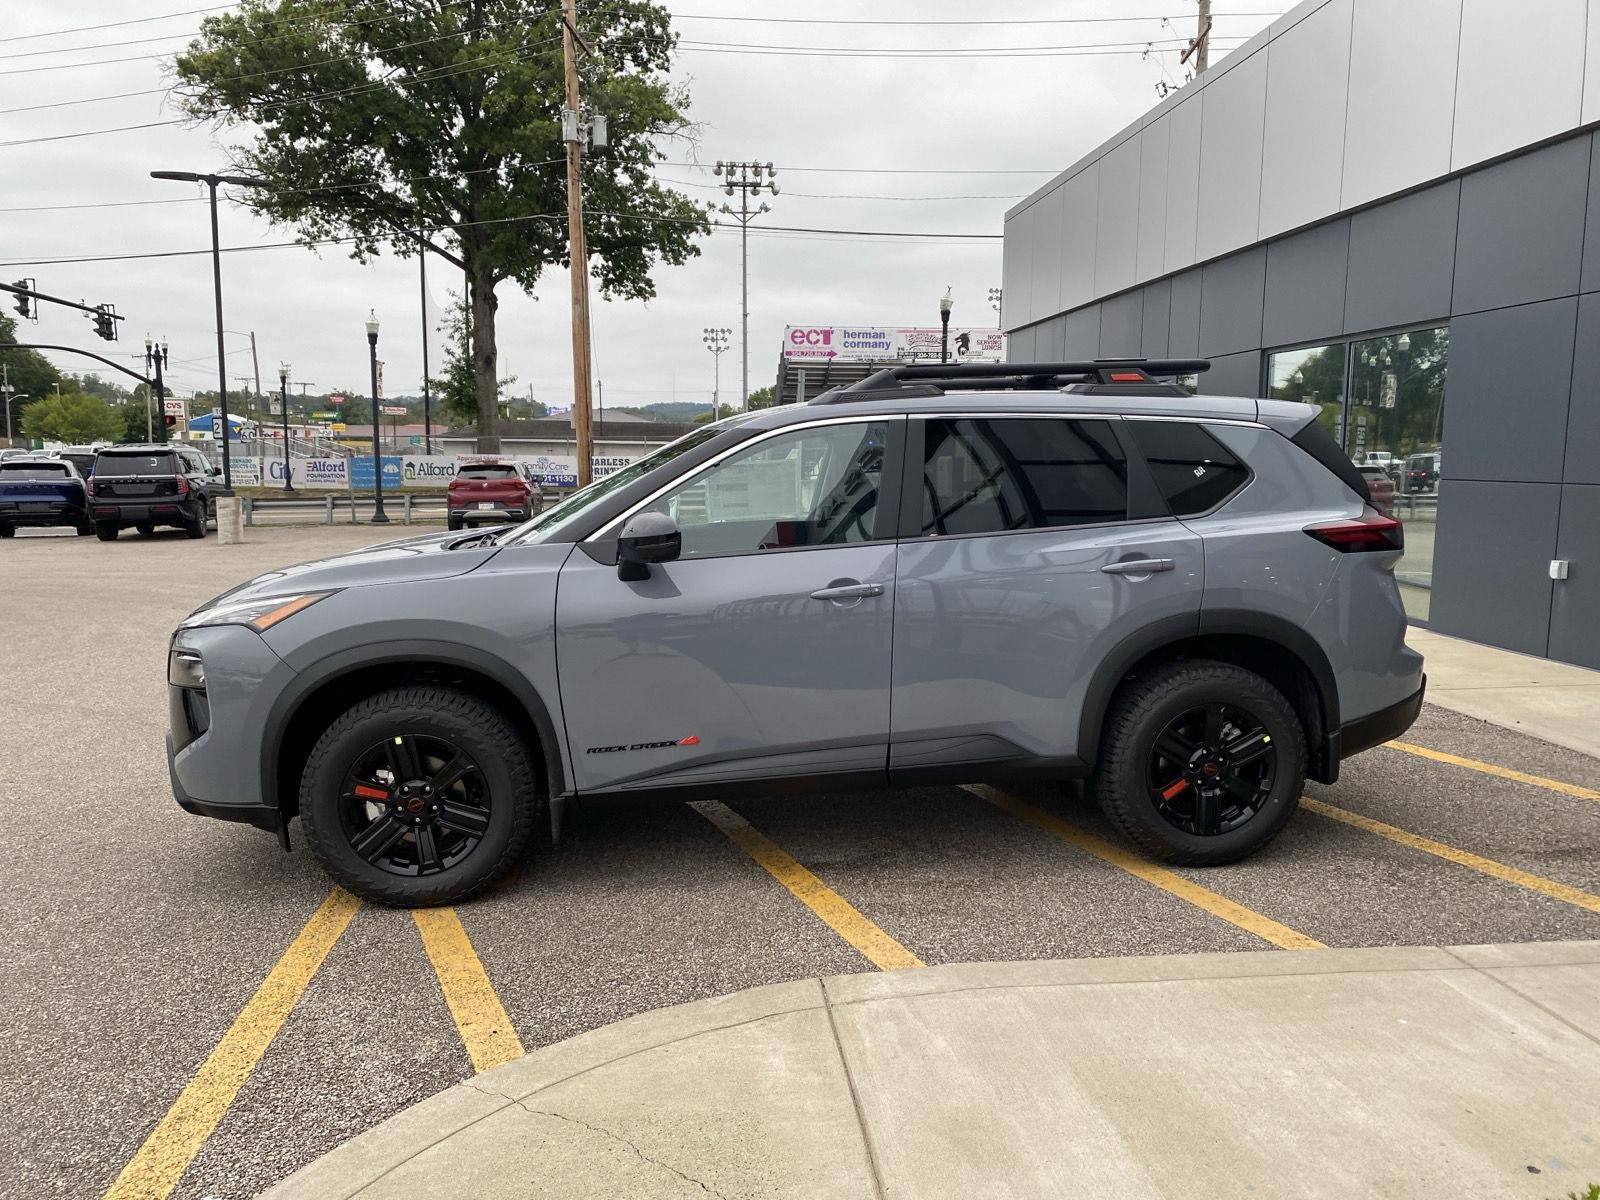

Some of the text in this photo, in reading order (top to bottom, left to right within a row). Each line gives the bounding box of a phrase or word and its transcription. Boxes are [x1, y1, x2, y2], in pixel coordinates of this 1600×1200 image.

[843, 329, 886, 339] herman
[843, 340, 891, 351] cormany
[242, 432, 255, 441] 60
[312, 461, 345, 472] Alford
[417, 462, 455, 476] Alford
[587, 740, 679, 754] ROCK CREEK
